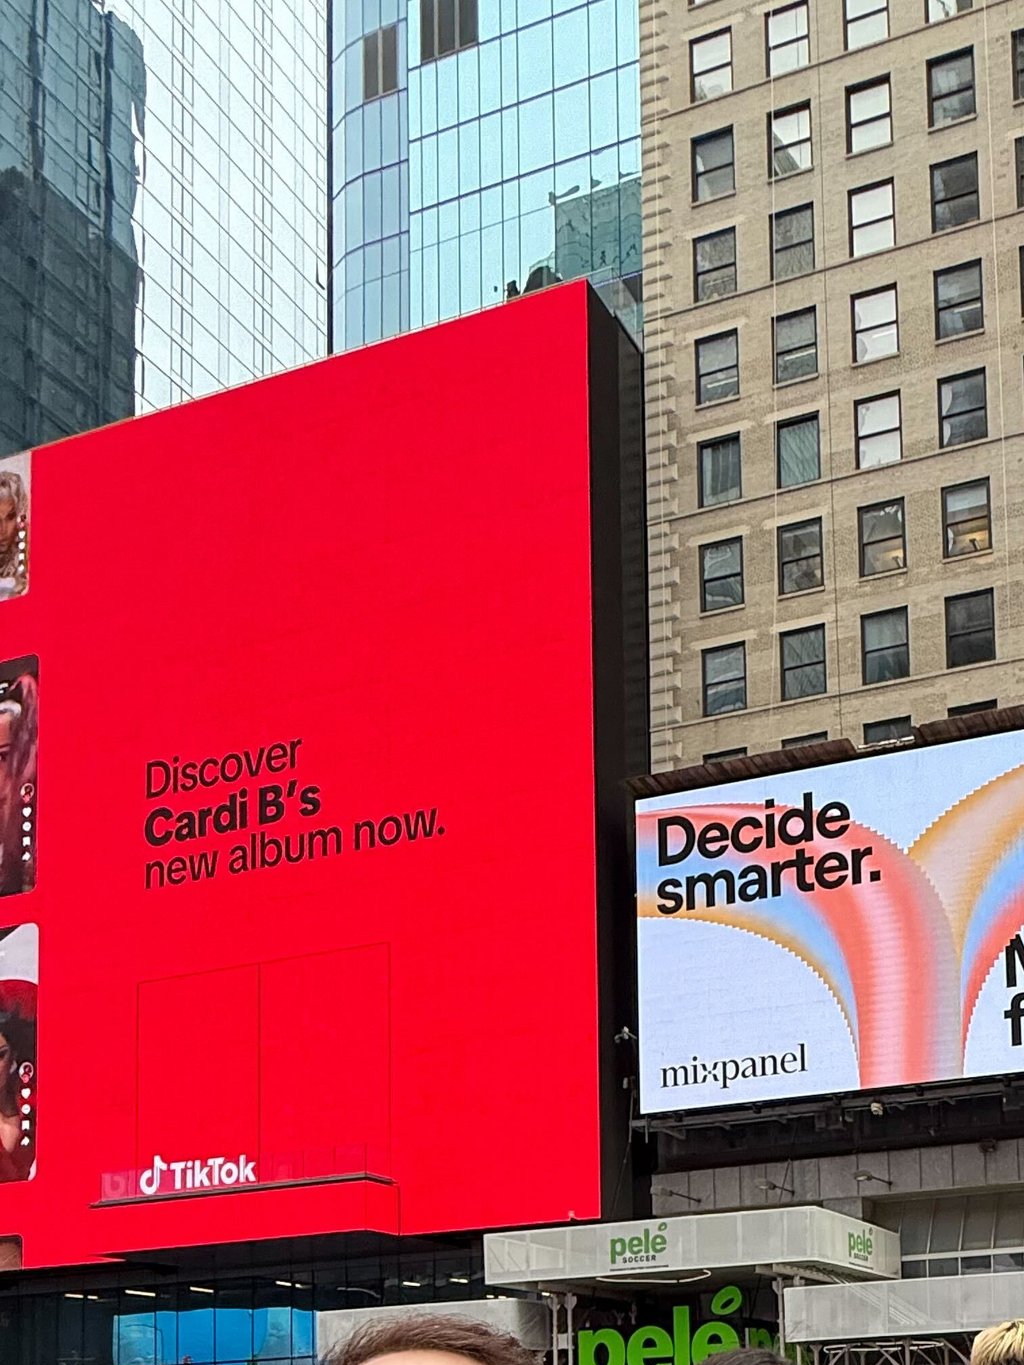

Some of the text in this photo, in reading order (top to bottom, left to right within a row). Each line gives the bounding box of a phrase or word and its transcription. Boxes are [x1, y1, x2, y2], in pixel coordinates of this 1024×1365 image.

[145, 738, 302, 799] Discover
[144, 779, 321, 847] Cardi B's
[657, 791, 851, 867] Decide
[145, 808, 446, 889] new album now.
[656, 846, 881, 915] smarter.
[660, 1043, 808, 1090] mixpanel
[169, 1154, 257, 1190] TikTok
[622, 1254, 657, 1264] SOCCER
